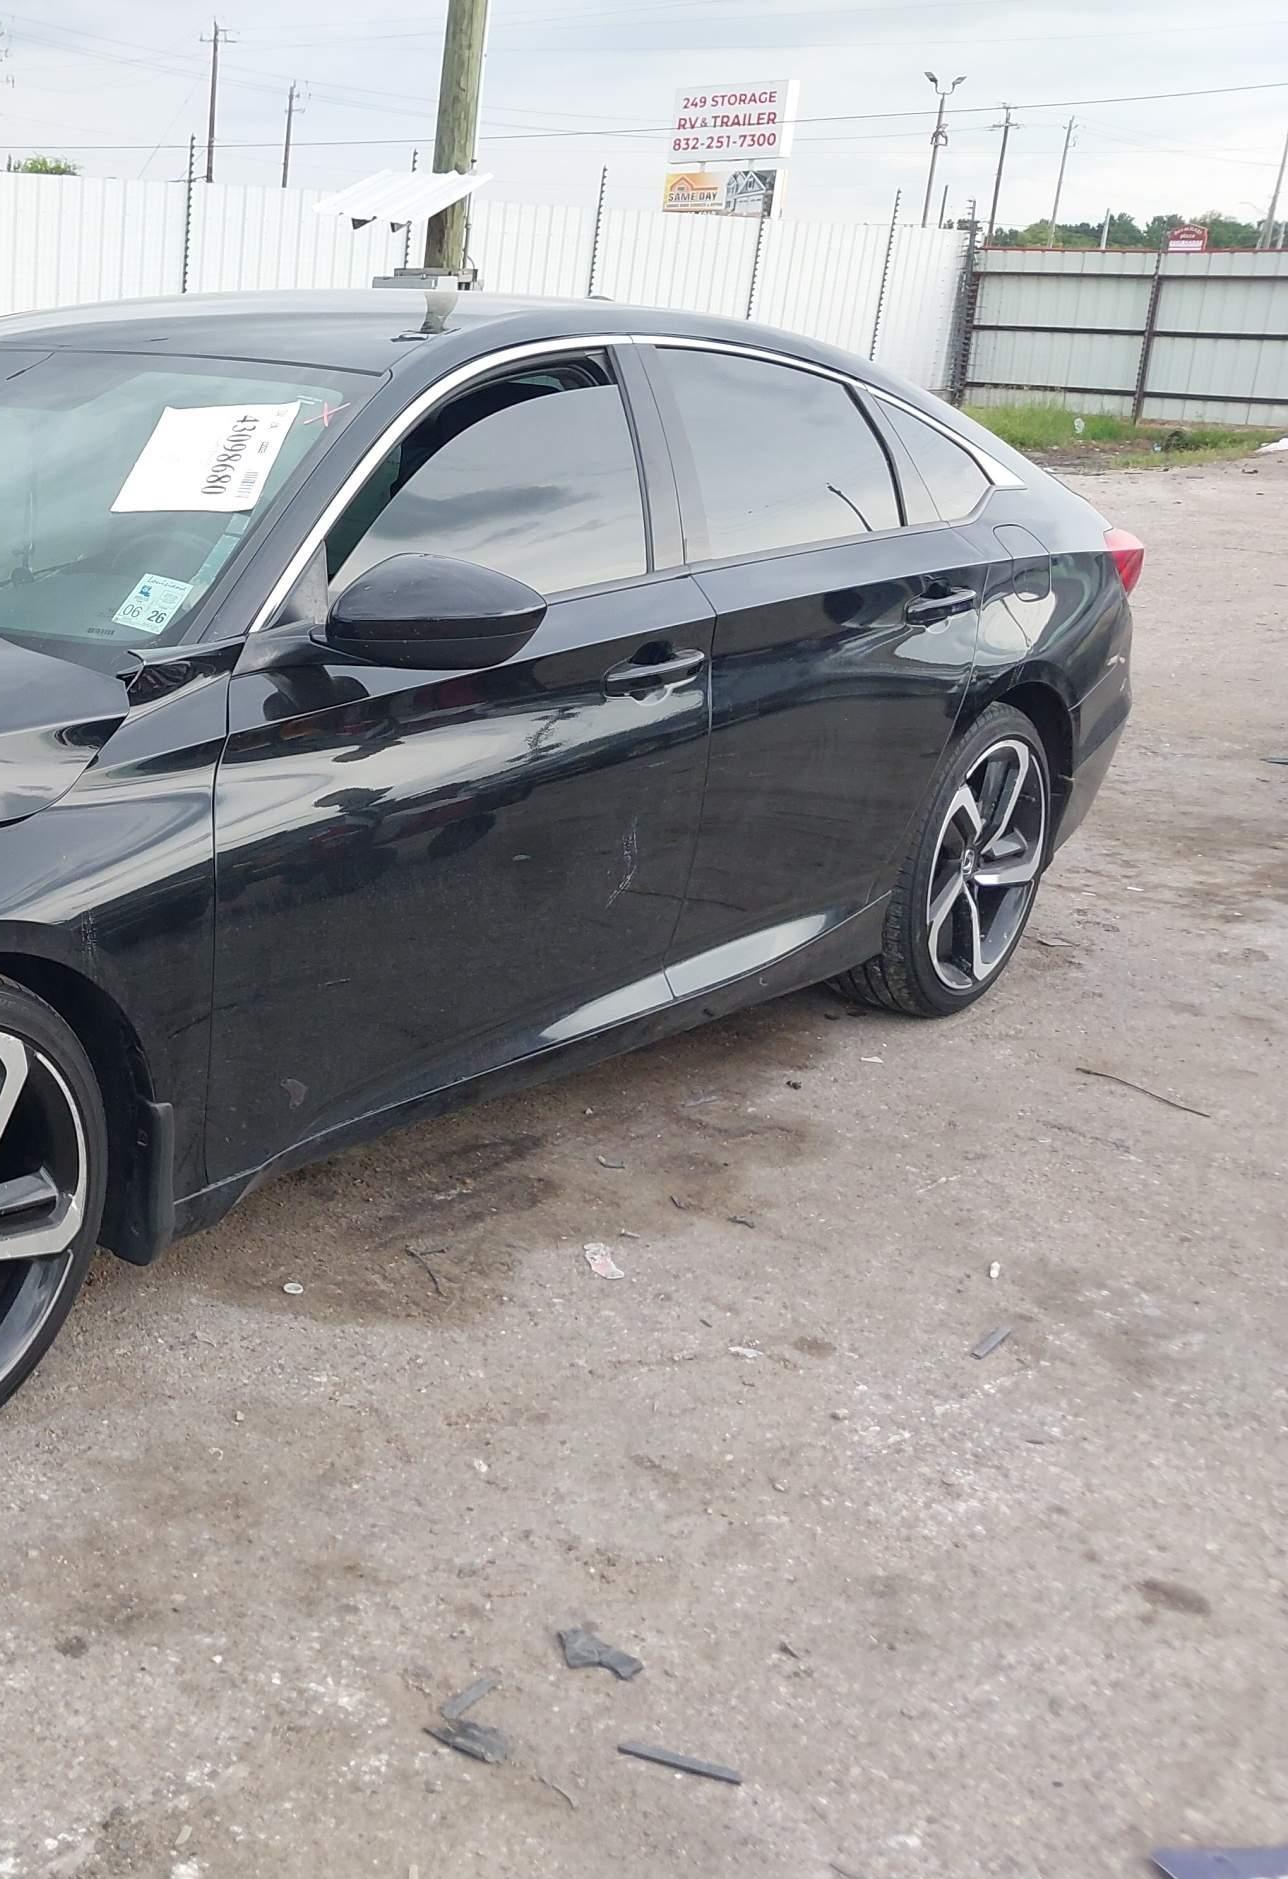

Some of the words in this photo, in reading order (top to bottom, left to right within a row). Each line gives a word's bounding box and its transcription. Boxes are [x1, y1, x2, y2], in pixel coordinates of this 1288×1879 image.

[683, 96, 707, 109] 249
[711, 91, 777, 107] STORAGE
[677, 116, 699, 131] RV
[700, 117, 708, 127] &
[711, 111, 777, 128] TRAILER
[673, 133, 776, 151] 832-251-7300
[668, 192, 697, 202] SAME
[698, 191, 718, 201] DAY
[201, 414, 260, 495] 43098680
[123, 604, 142, 617] 06
[147, 611, 166, 624] 26
